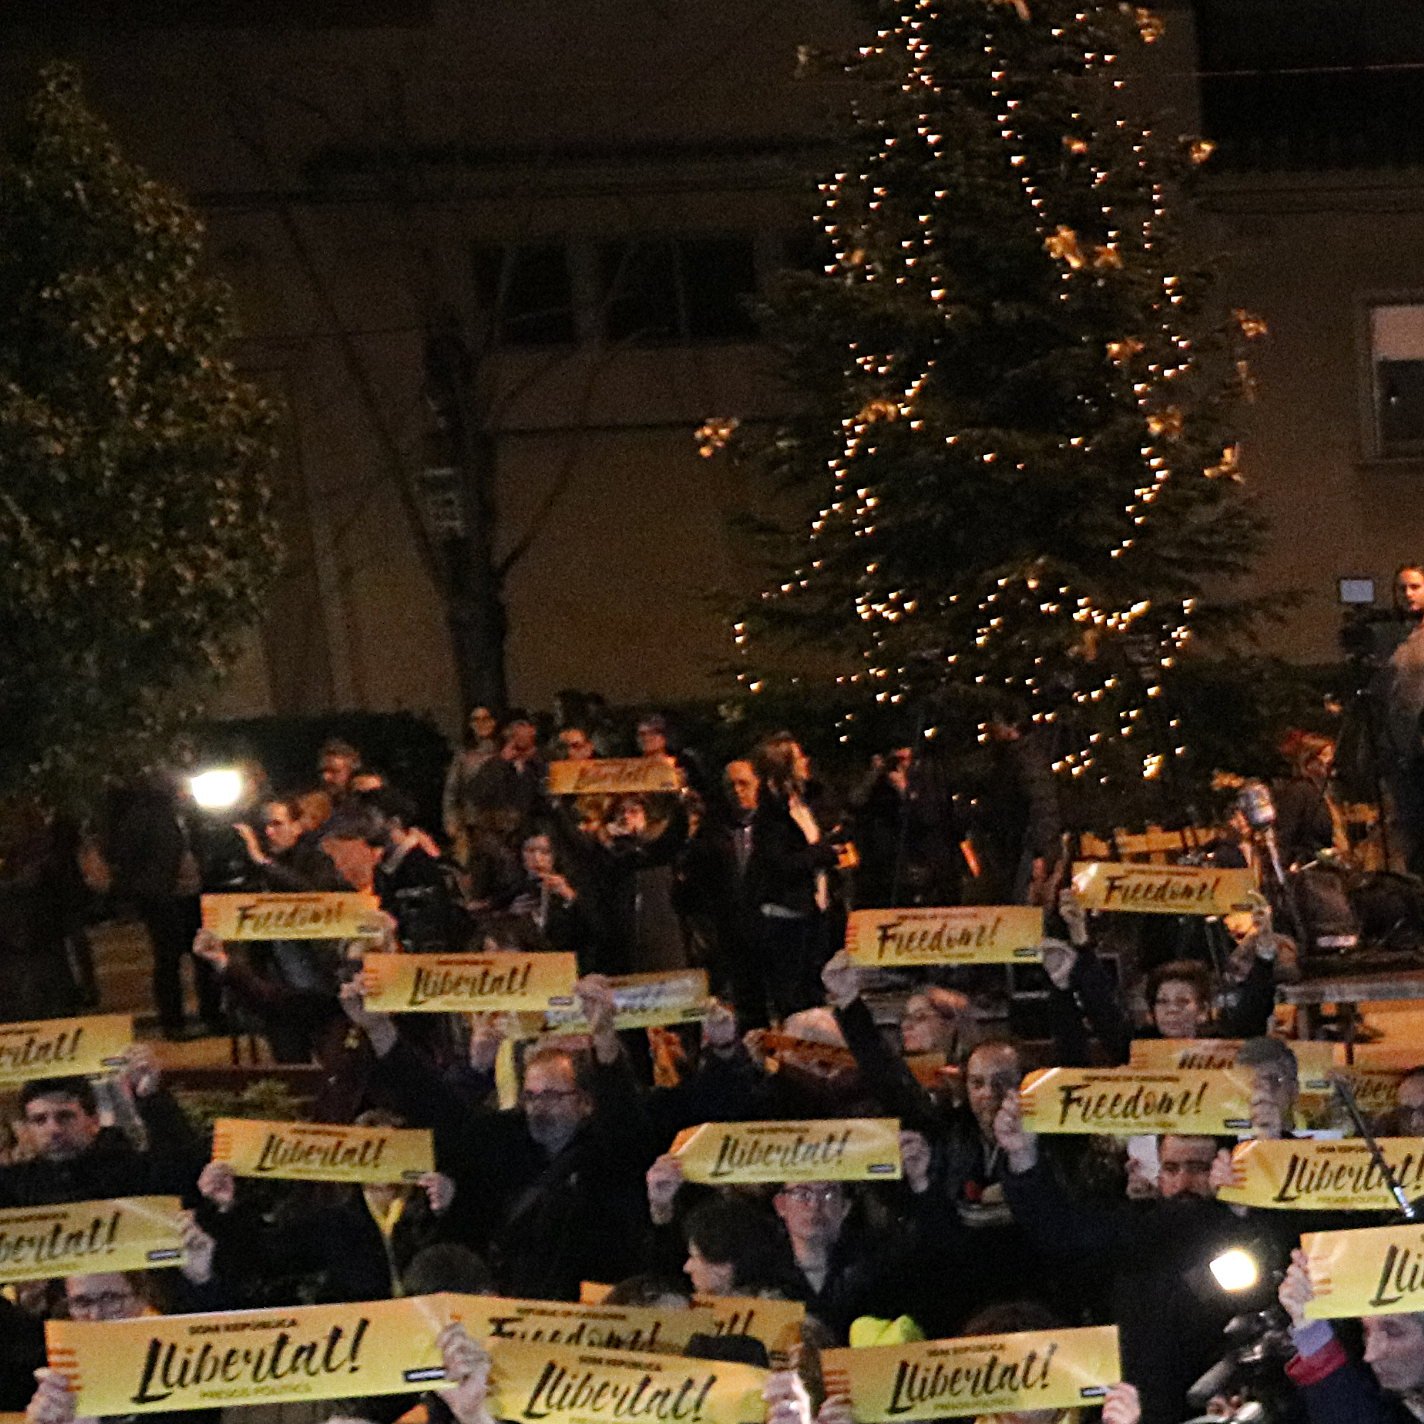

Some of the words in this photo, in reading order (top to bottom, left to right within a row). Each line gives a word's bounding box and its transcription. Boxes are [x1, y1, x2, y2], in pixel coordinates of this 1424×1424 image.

[877, 919, 1000, 959] Freedom!
[1058, 1078, 1204, 1126] Freedom!
[258, 1136, 388, 1171] Llibertat!
[711, 1136, 847, 1175] Llibertat!
[131, 1319, 370, 1403] Llibertat!
[886, 1341, 1058, 1414] Llibertat!
[524, 1366, 716, 1420] Llibertat!
